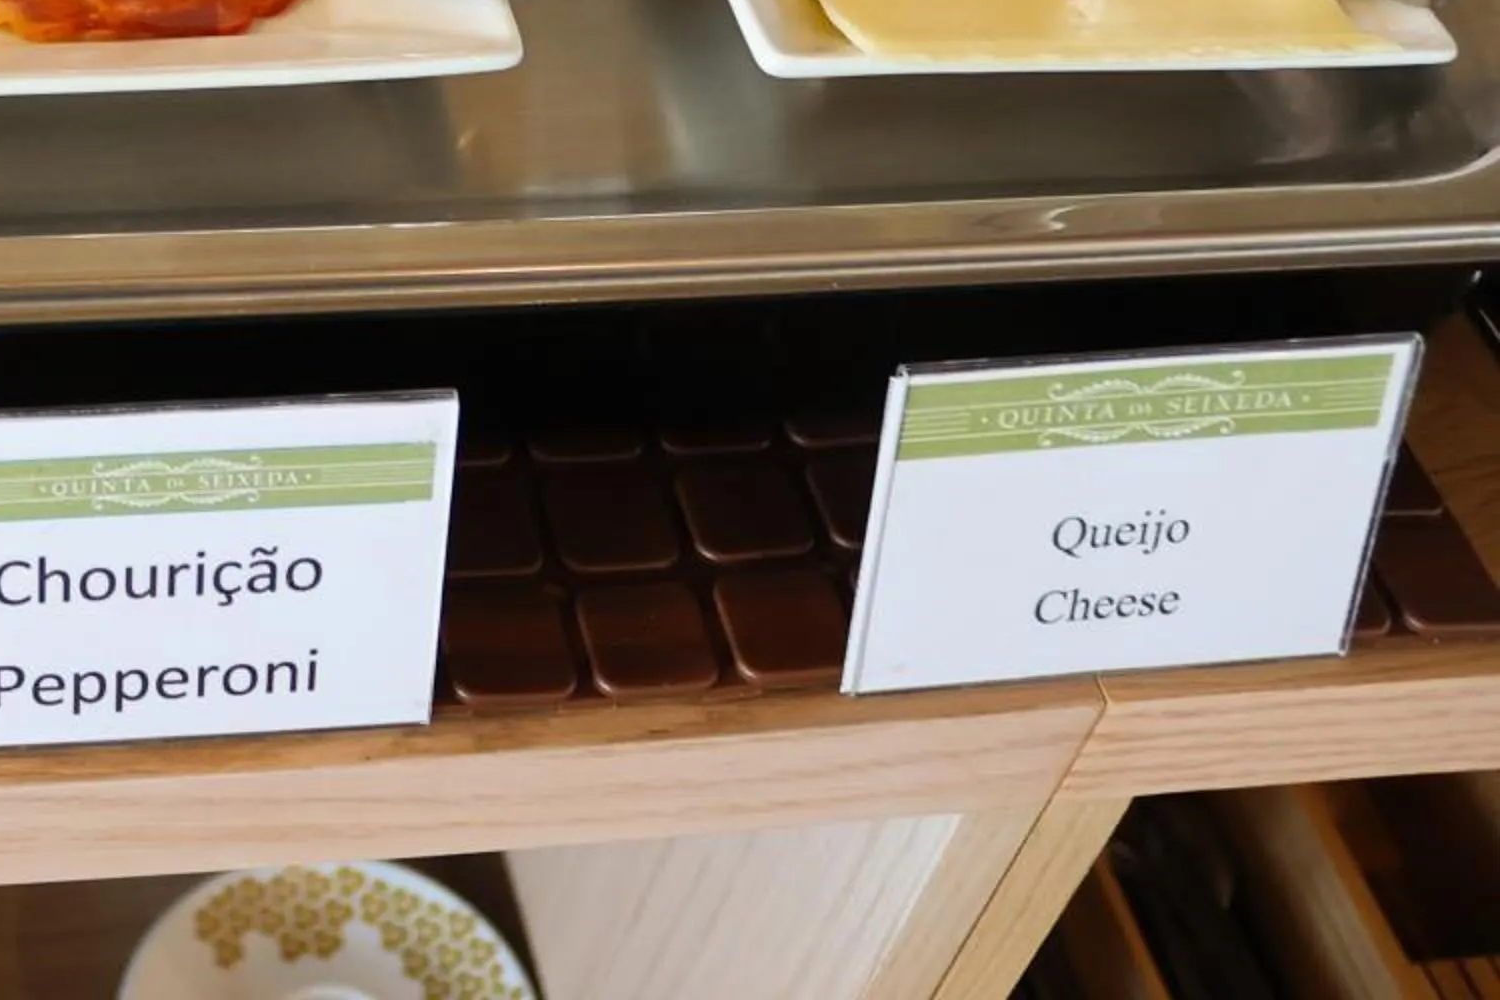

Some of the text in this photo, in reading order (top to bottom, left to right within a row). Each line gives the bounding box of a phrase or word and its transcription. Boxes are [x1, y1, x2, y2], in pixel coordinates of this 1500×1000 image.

[999, 401, 1115, 429] QUINTA
[1166, 390, 1293, 416] SEIXEDA
[51, 477, 152, 497] QUINTA
[198, 471, 299, 489] SEIXEDA
[1051, 509, 1191, 559] Queijo
[1033, 588, 1181, 625] Cheese
